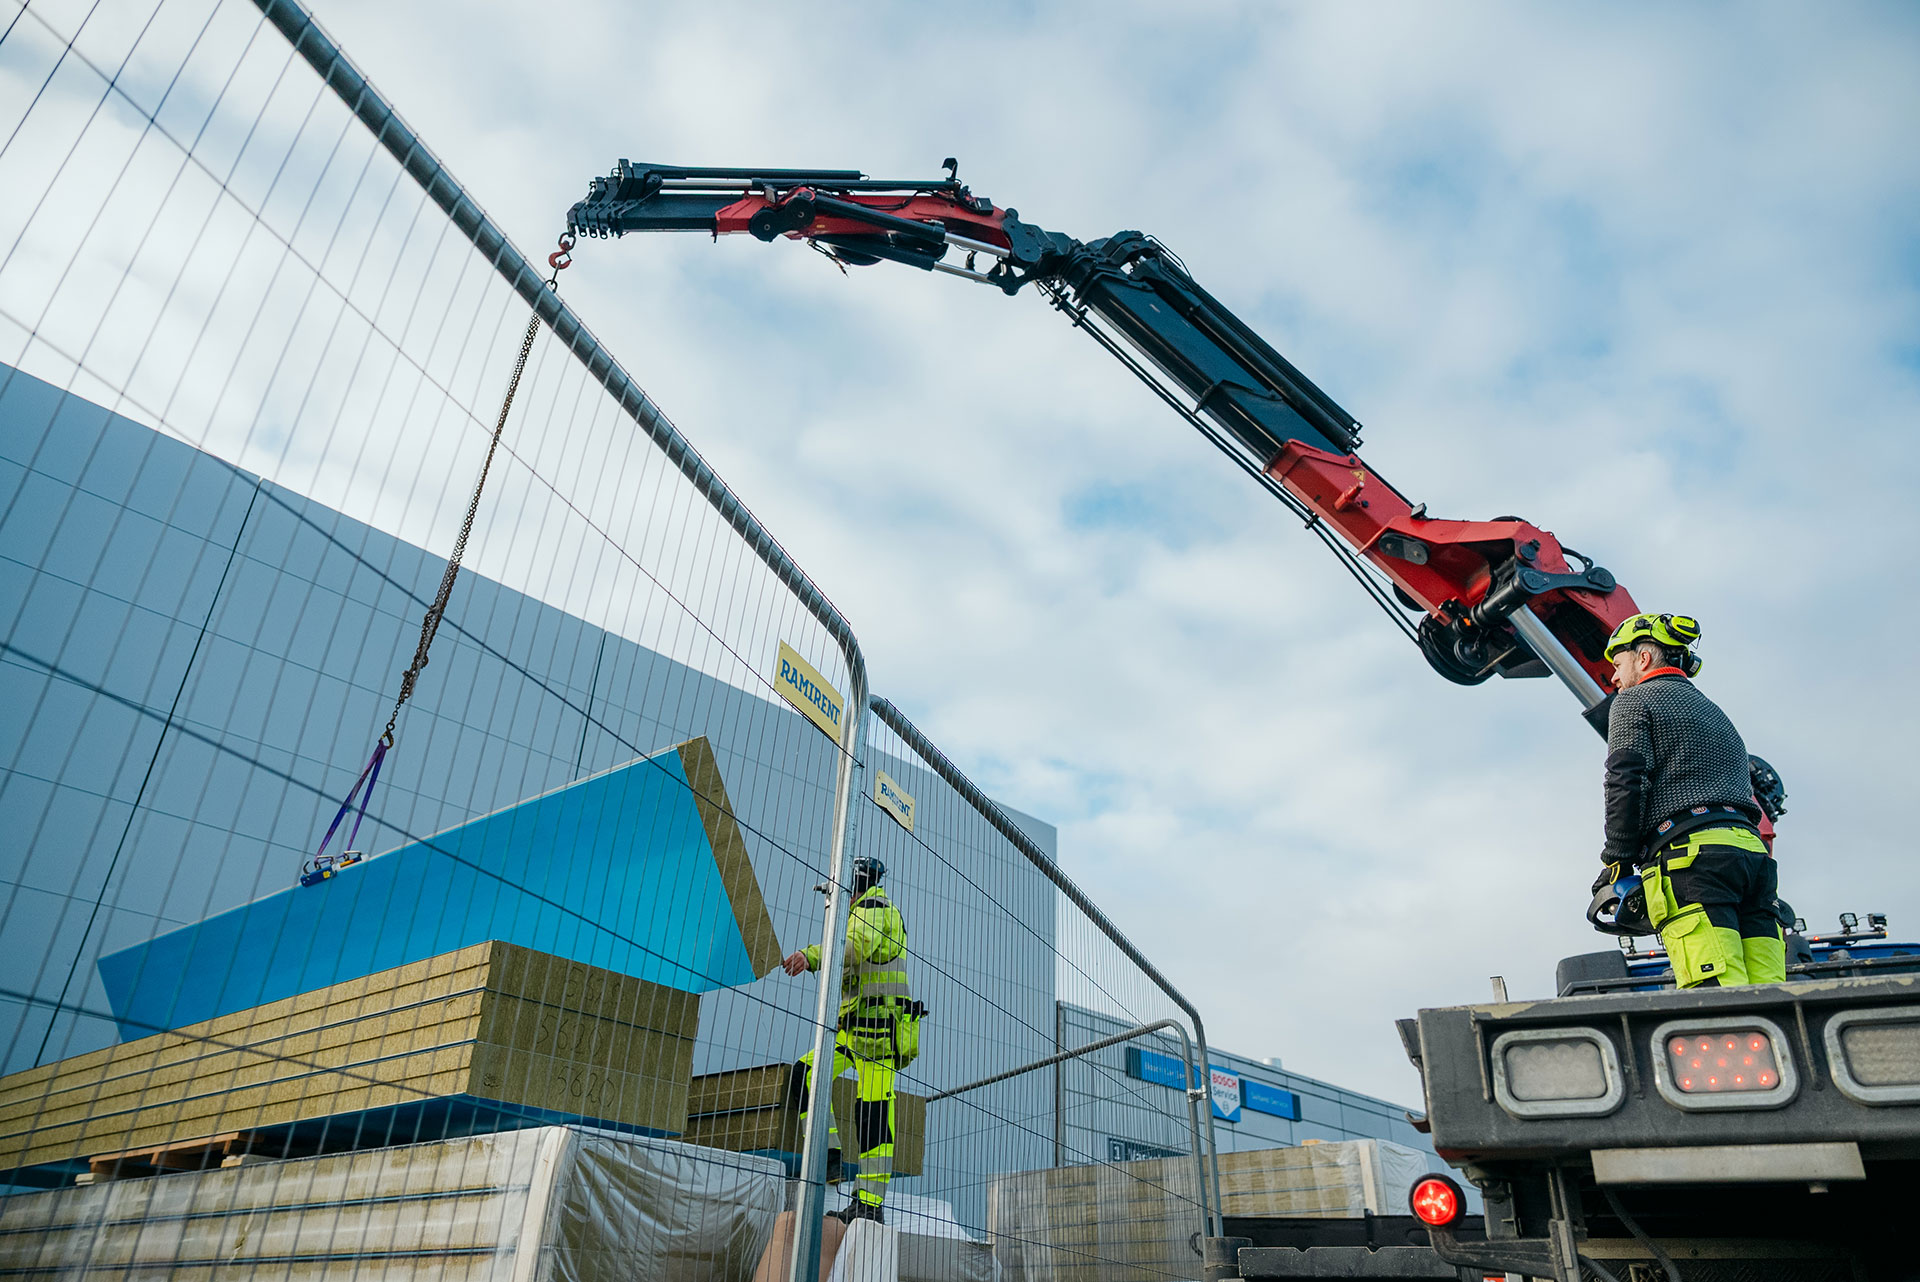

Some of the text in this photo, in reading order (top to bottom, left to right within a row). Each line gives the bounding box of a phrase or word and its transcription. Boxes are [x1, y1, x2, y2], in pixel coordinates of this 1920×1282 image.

[780, 659, 840, 725] RAMIRENT
[537, 1013, 603, 1057] 5620
[558, 1066, 615, 1107] 5620
[1212, 1073, 1237, 1090] BOSCH
[1213, 1086, 1238, 1102] Service
